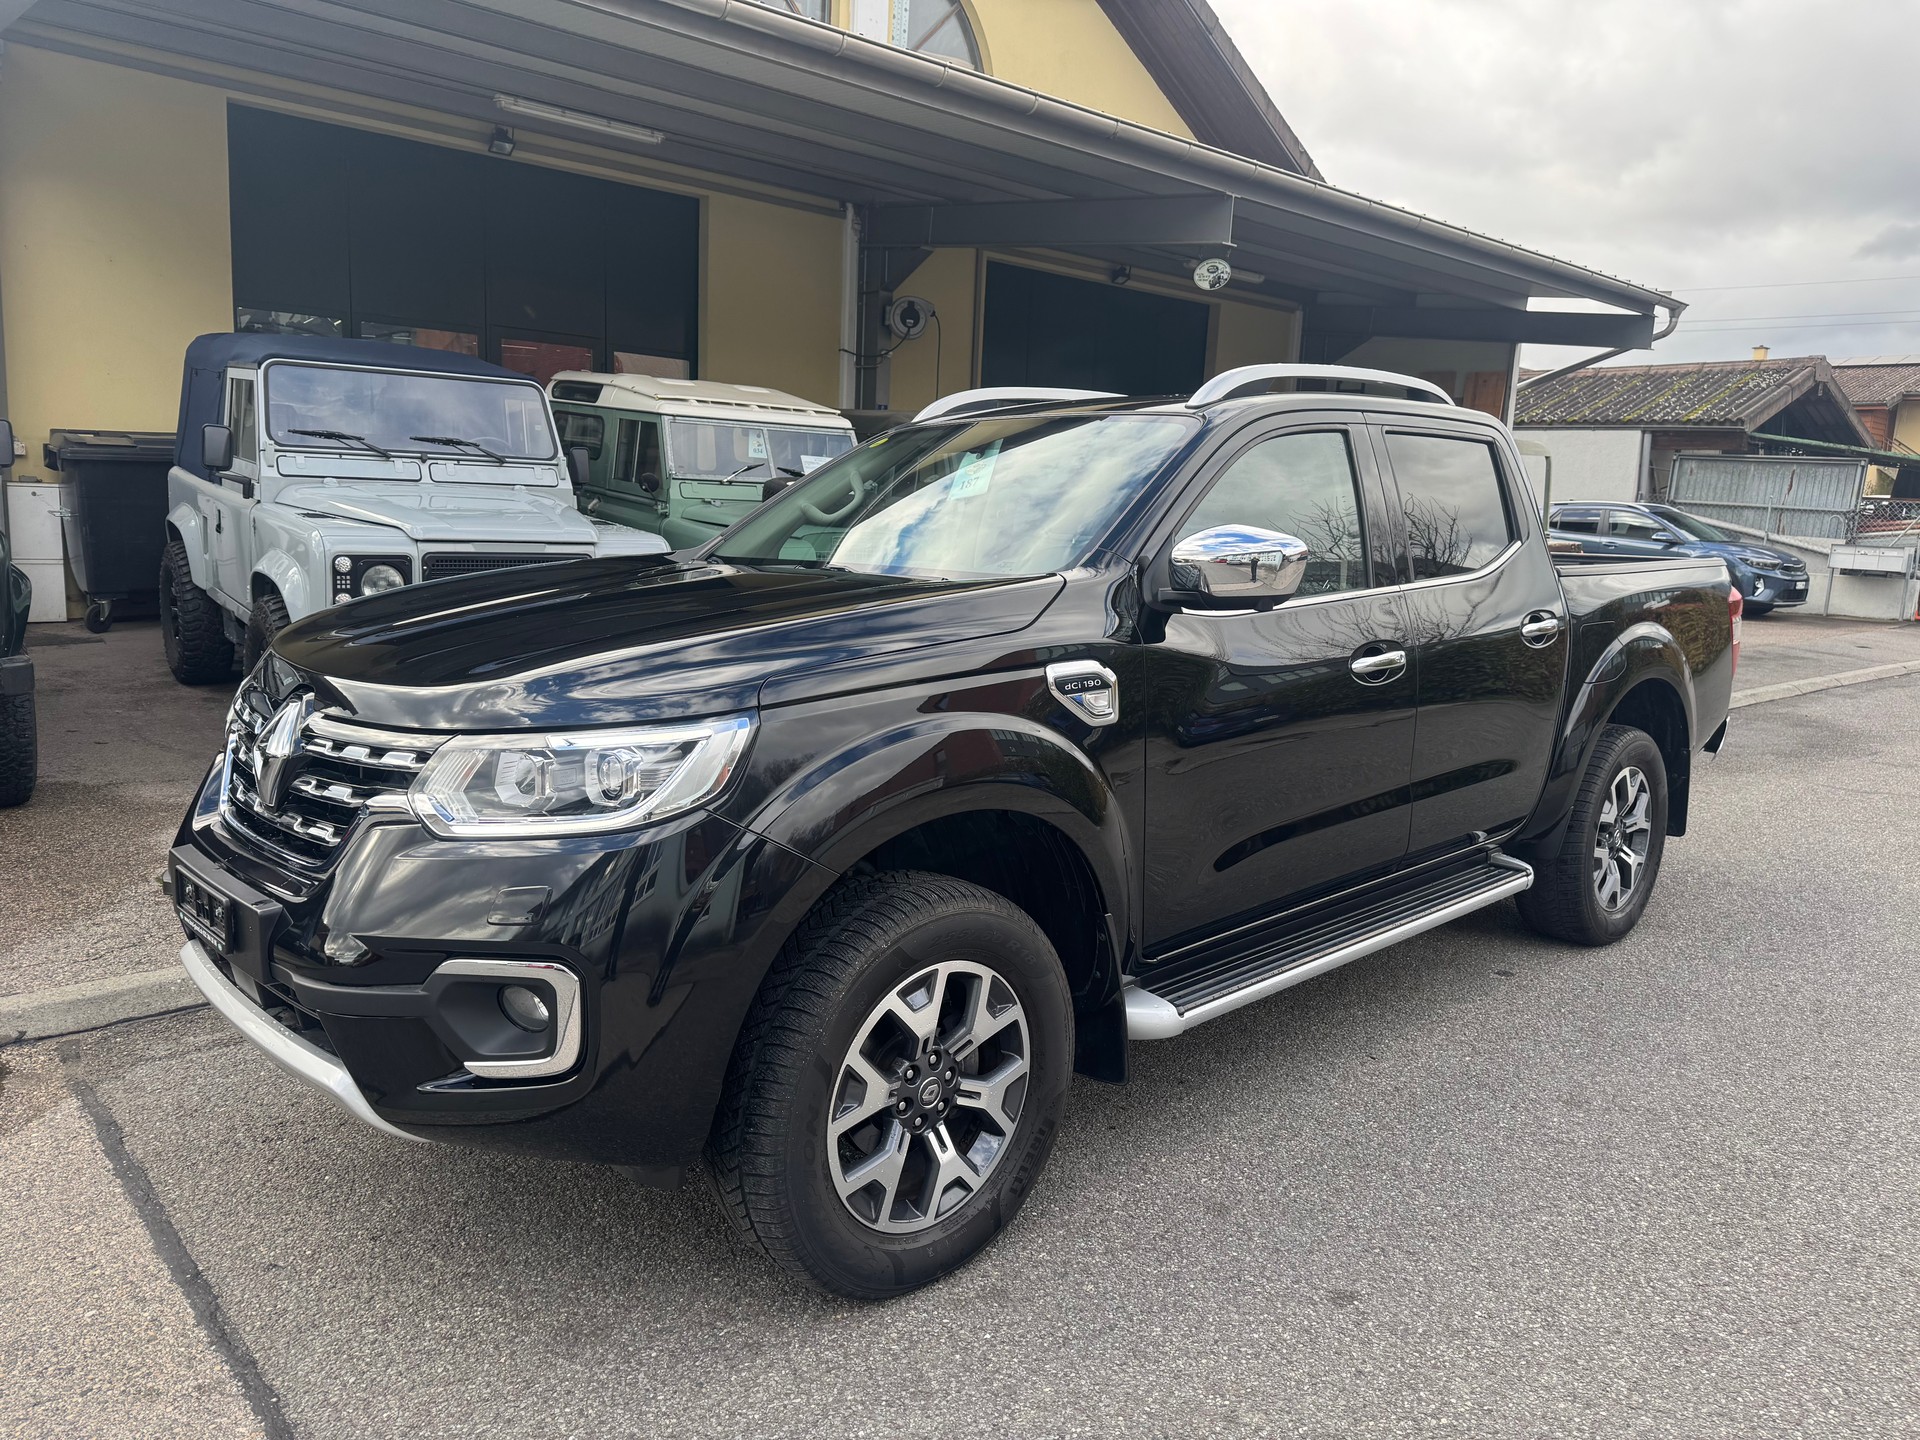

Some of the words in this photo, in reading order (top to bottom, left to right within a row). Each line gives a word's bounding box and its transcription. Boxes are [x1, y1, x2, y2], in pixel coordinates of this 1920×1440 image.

[960, 476, 980, 490] 187
[1065, 681, 1081, 690] dCi
[1083, 679, 1101, 687] 190
